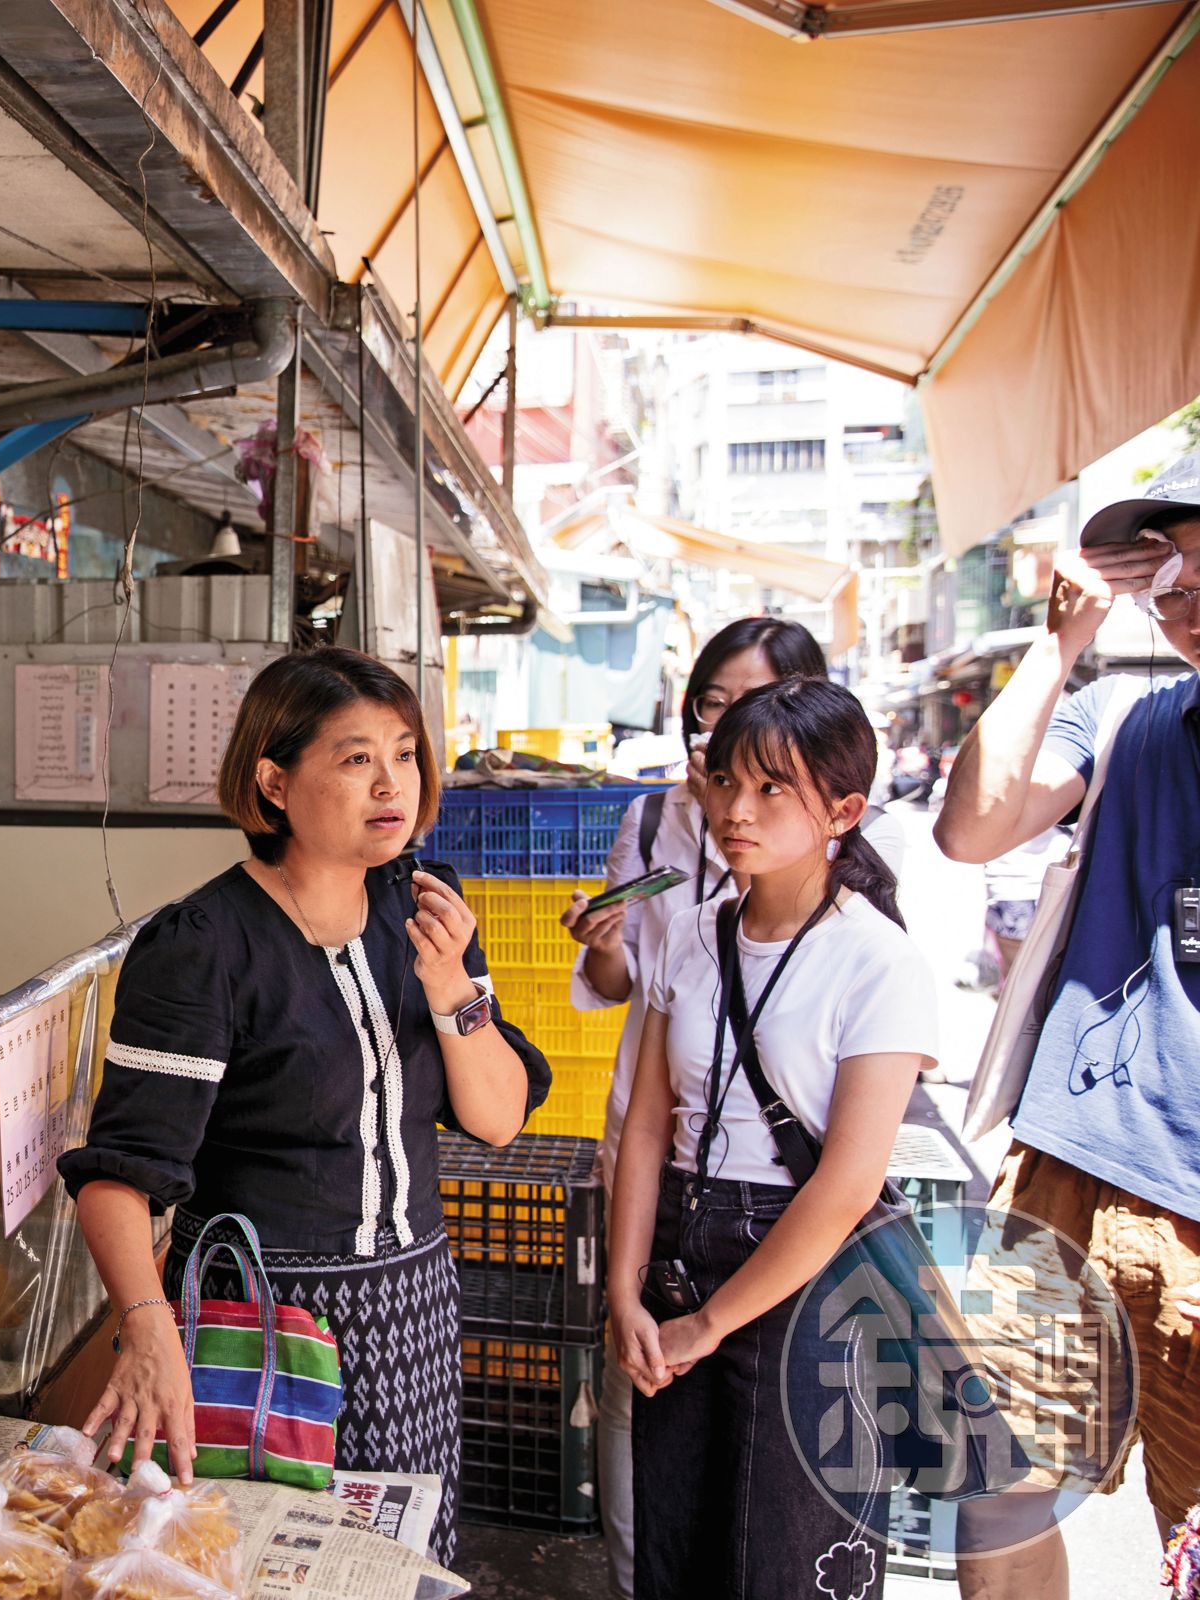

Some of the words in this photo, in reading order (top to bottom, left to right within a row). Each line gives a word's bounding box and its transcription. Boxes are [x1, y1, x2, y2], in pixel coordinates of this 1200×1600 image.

[32, 1162, 38, 1182] 15
[39, 1155, 45, 1174] 15
[16, 1178, 23, 1198] 20
[24, 1170, 31, 1190] 15
[6, 1186, 14, 1206] 25
